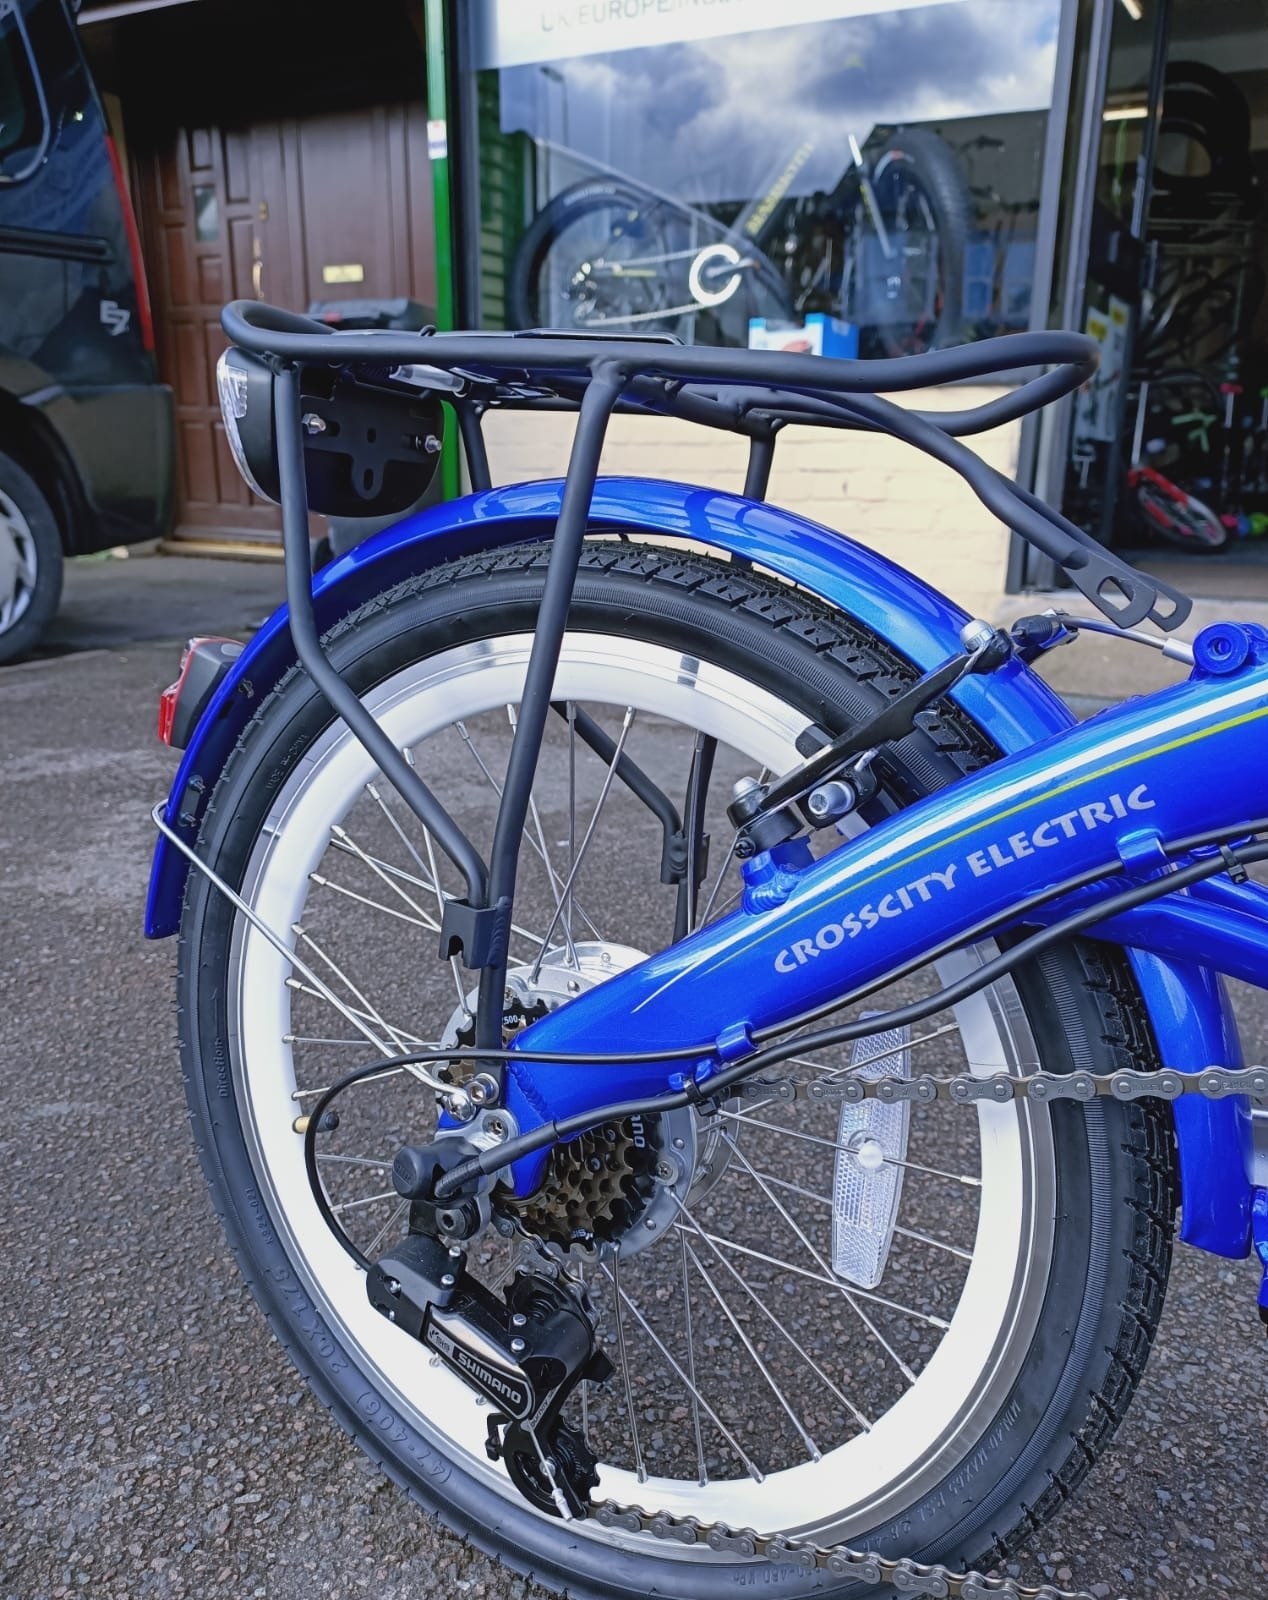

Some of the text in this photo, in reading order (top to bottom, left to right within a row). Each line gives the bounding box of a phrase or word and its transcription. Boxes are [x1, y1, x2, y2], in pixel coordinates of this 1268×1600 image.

[774, 783, 1156, 974] CROSSCITY ELECTRIC
[458, 1354, 522, 1406] SHIMANO
